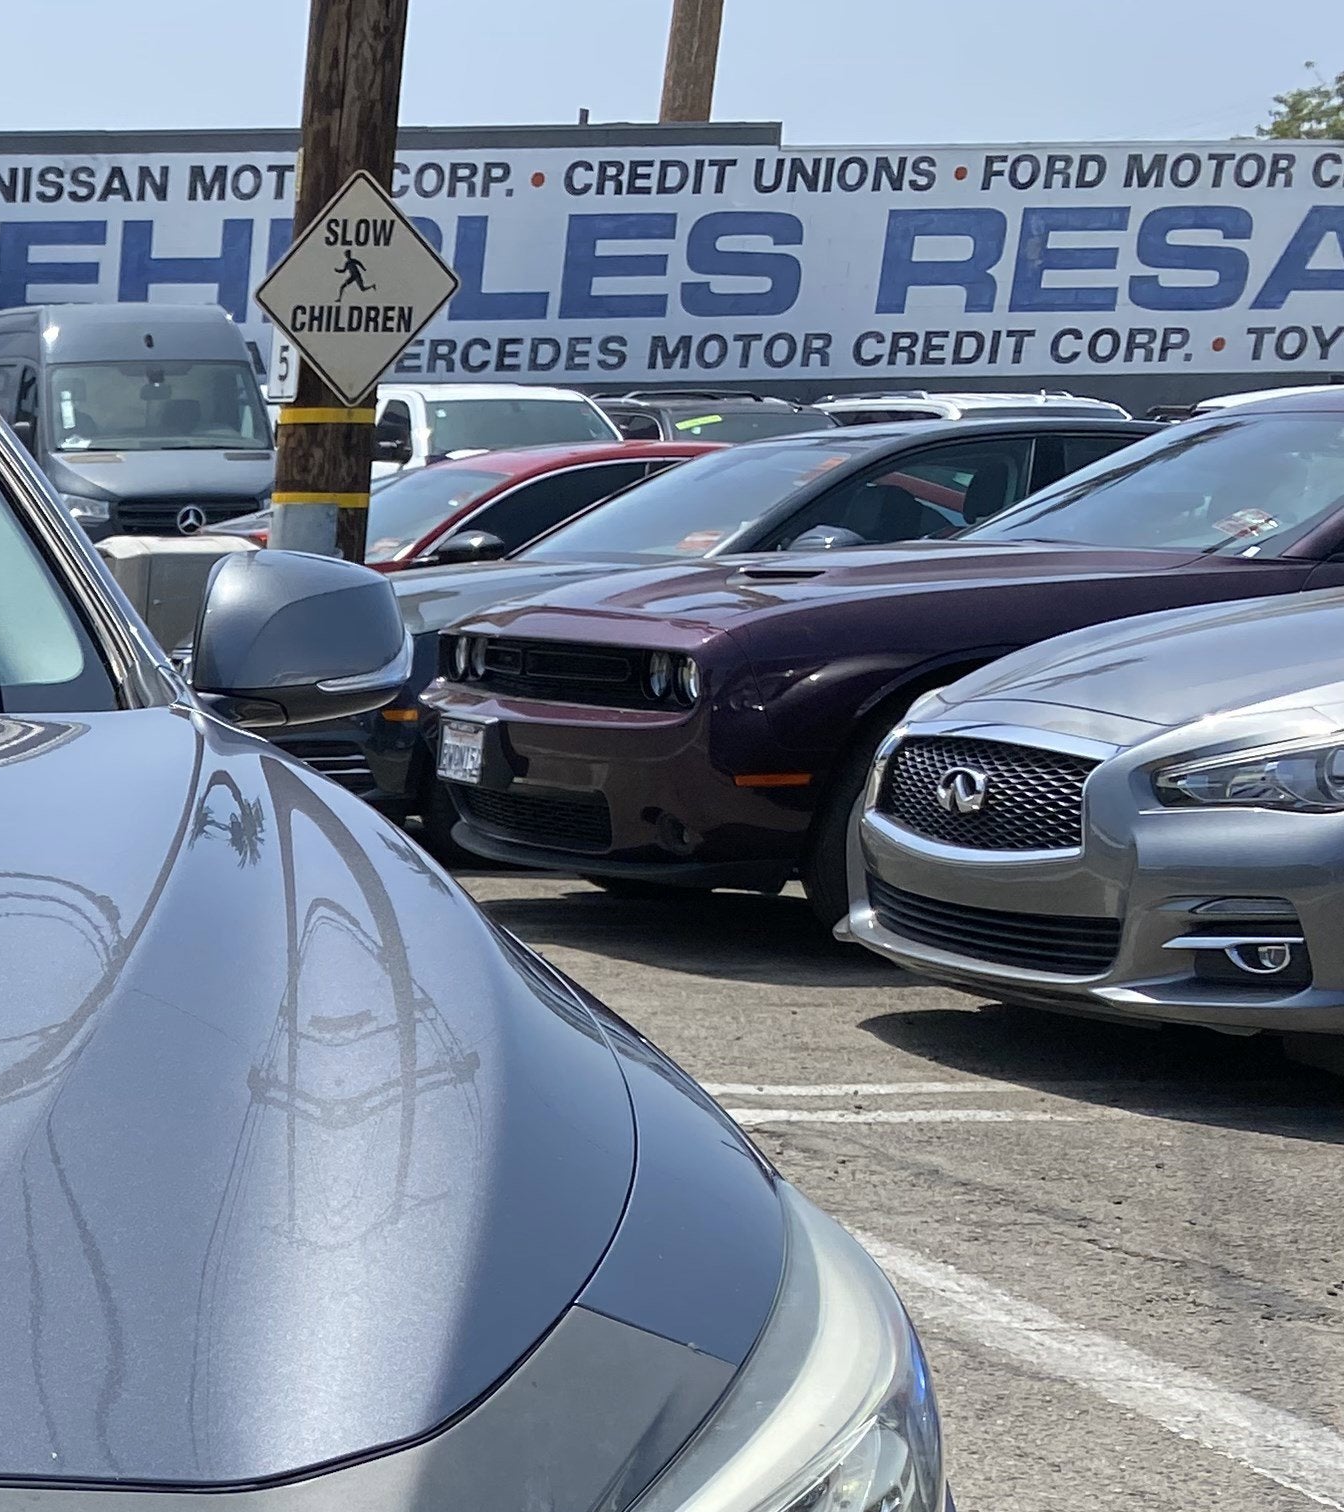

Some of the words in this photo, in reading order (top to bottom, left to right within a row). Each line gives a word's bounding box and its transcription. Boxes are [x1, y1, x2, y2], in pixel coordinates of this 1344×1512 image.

[187, 164, 295, 201] MOT
[564, 158, 737, 197] CREDIT
[753, 156, 937, 194] UNIONS
[980, 153, 1107, 191] FORD
[1123, 152, 1297, 189] MOTOR
[1312, 152, 1344, 189] C
[324, 218, 395, 247] SLOW
[874, 205, 1344, 314] RESA
[290, 304, 413, 333] CHILDREN
[394, 335, 627, 374] ERCEDES
[647, 332, 833, 371] MOTOR
[852, 329, 1036, 367] CREDIT
[1050, 326, 1193, 365] CORP.
[1246, 325, 1344, 361] TOY
